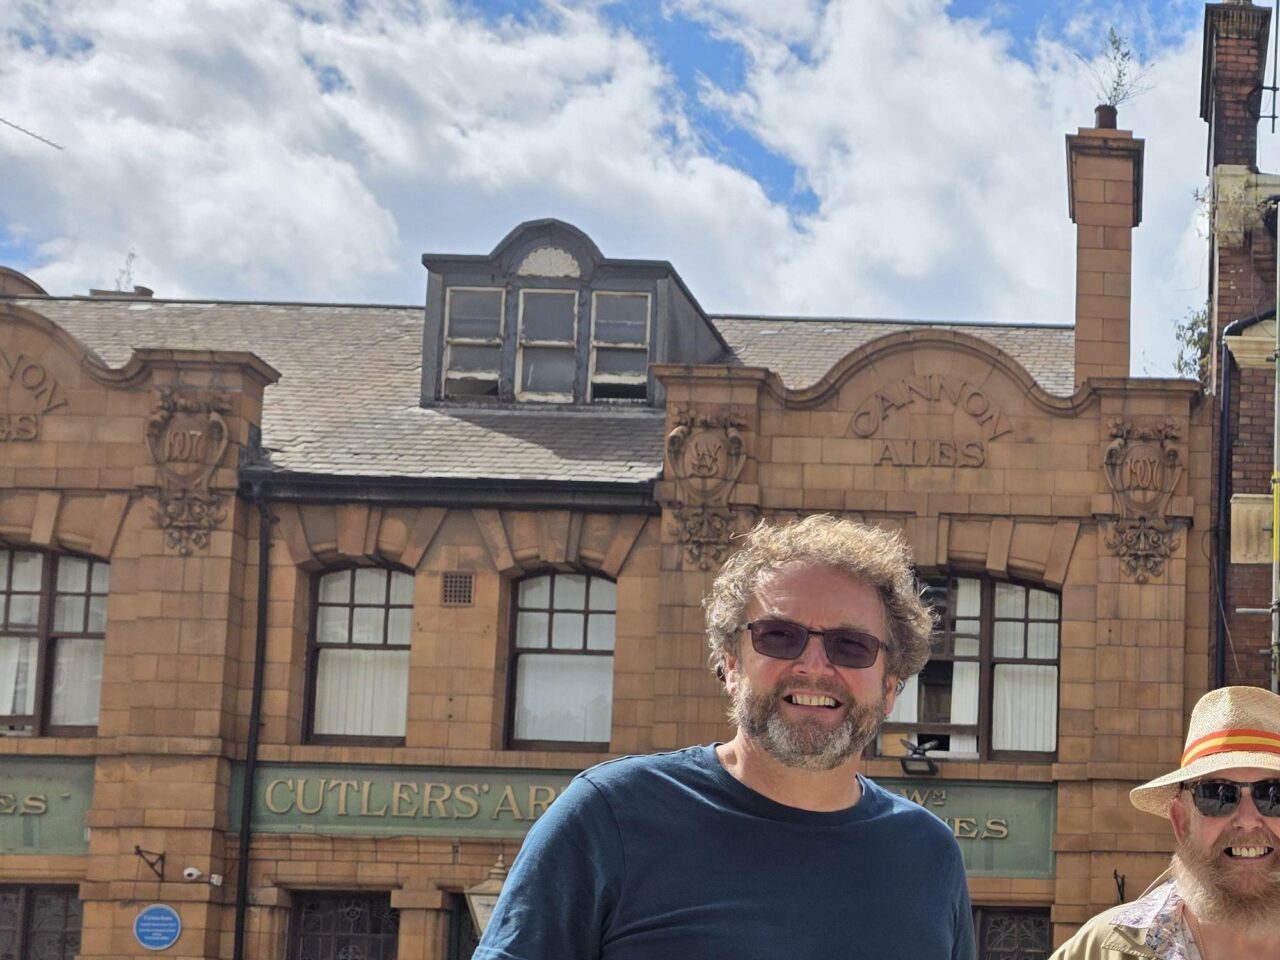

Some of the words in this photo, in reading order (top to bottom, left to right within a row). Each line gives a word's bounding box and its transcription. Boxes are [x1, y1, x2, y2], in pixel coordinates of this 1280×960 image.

[851, 374, 1013, 443] CANNON
[873, 440, 987, 469] ALES
[1121, 457, 1161, 491] 1907
[491, 784, 567, 821] AR
[944, 817, 1009, 840] ES
